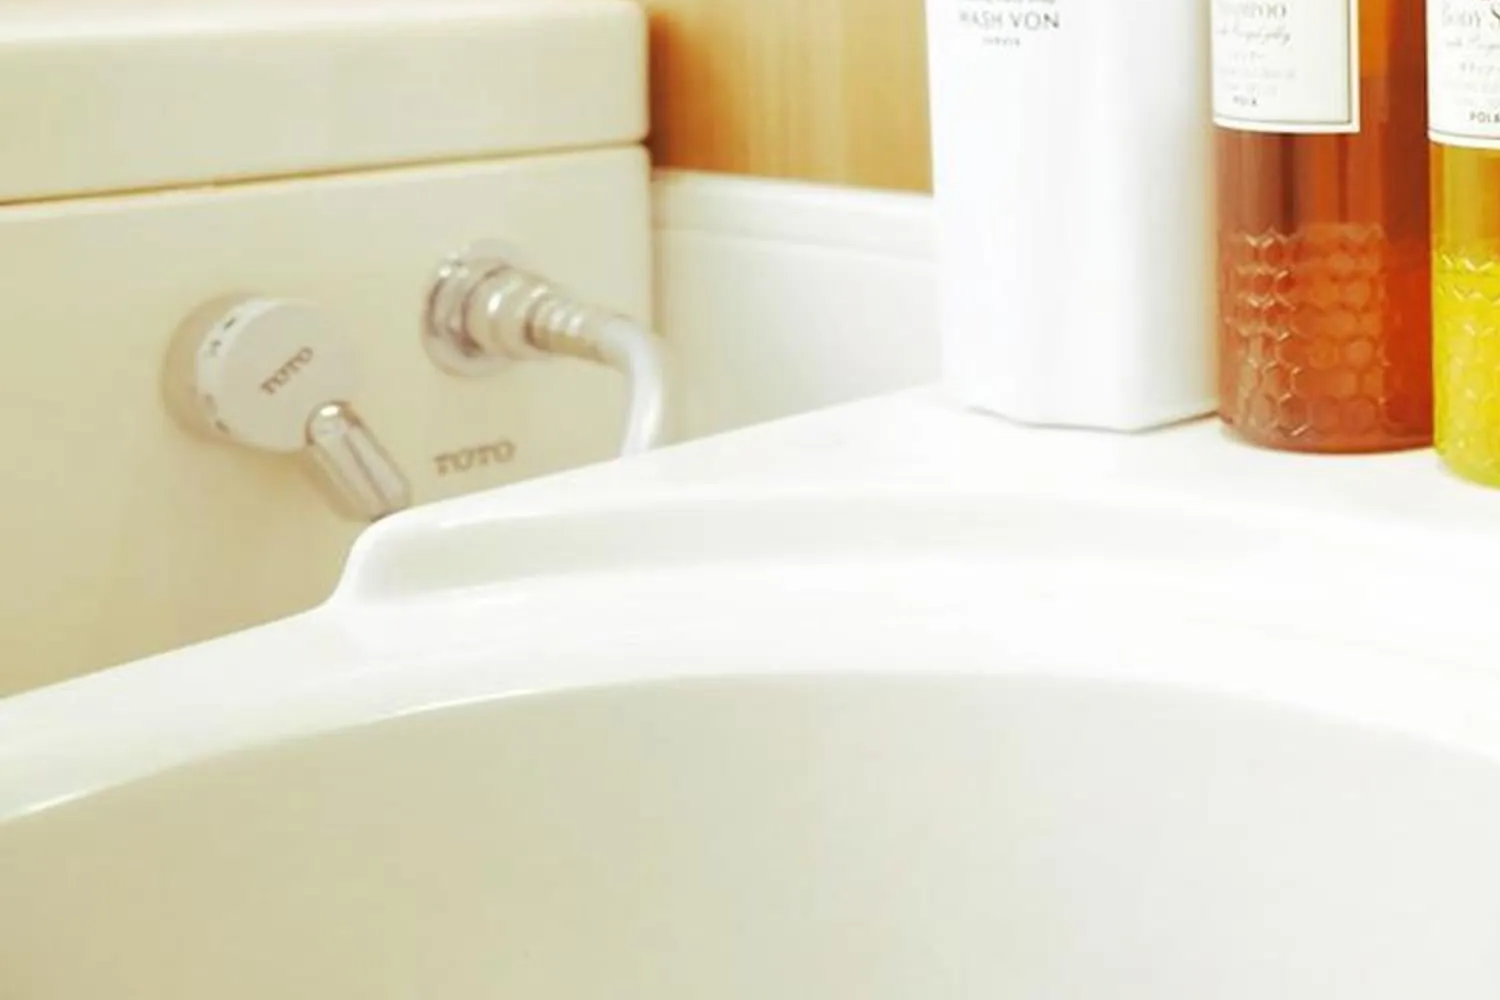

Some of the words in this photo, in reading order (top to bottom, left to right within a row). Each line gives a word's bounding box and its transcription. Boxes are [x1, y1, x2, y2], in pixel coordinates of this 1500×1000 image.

[1008, 10, 1061, 31] VON
[260, 345, 315, 396] TOTO
[433, 439, 518, 477] TOTO
